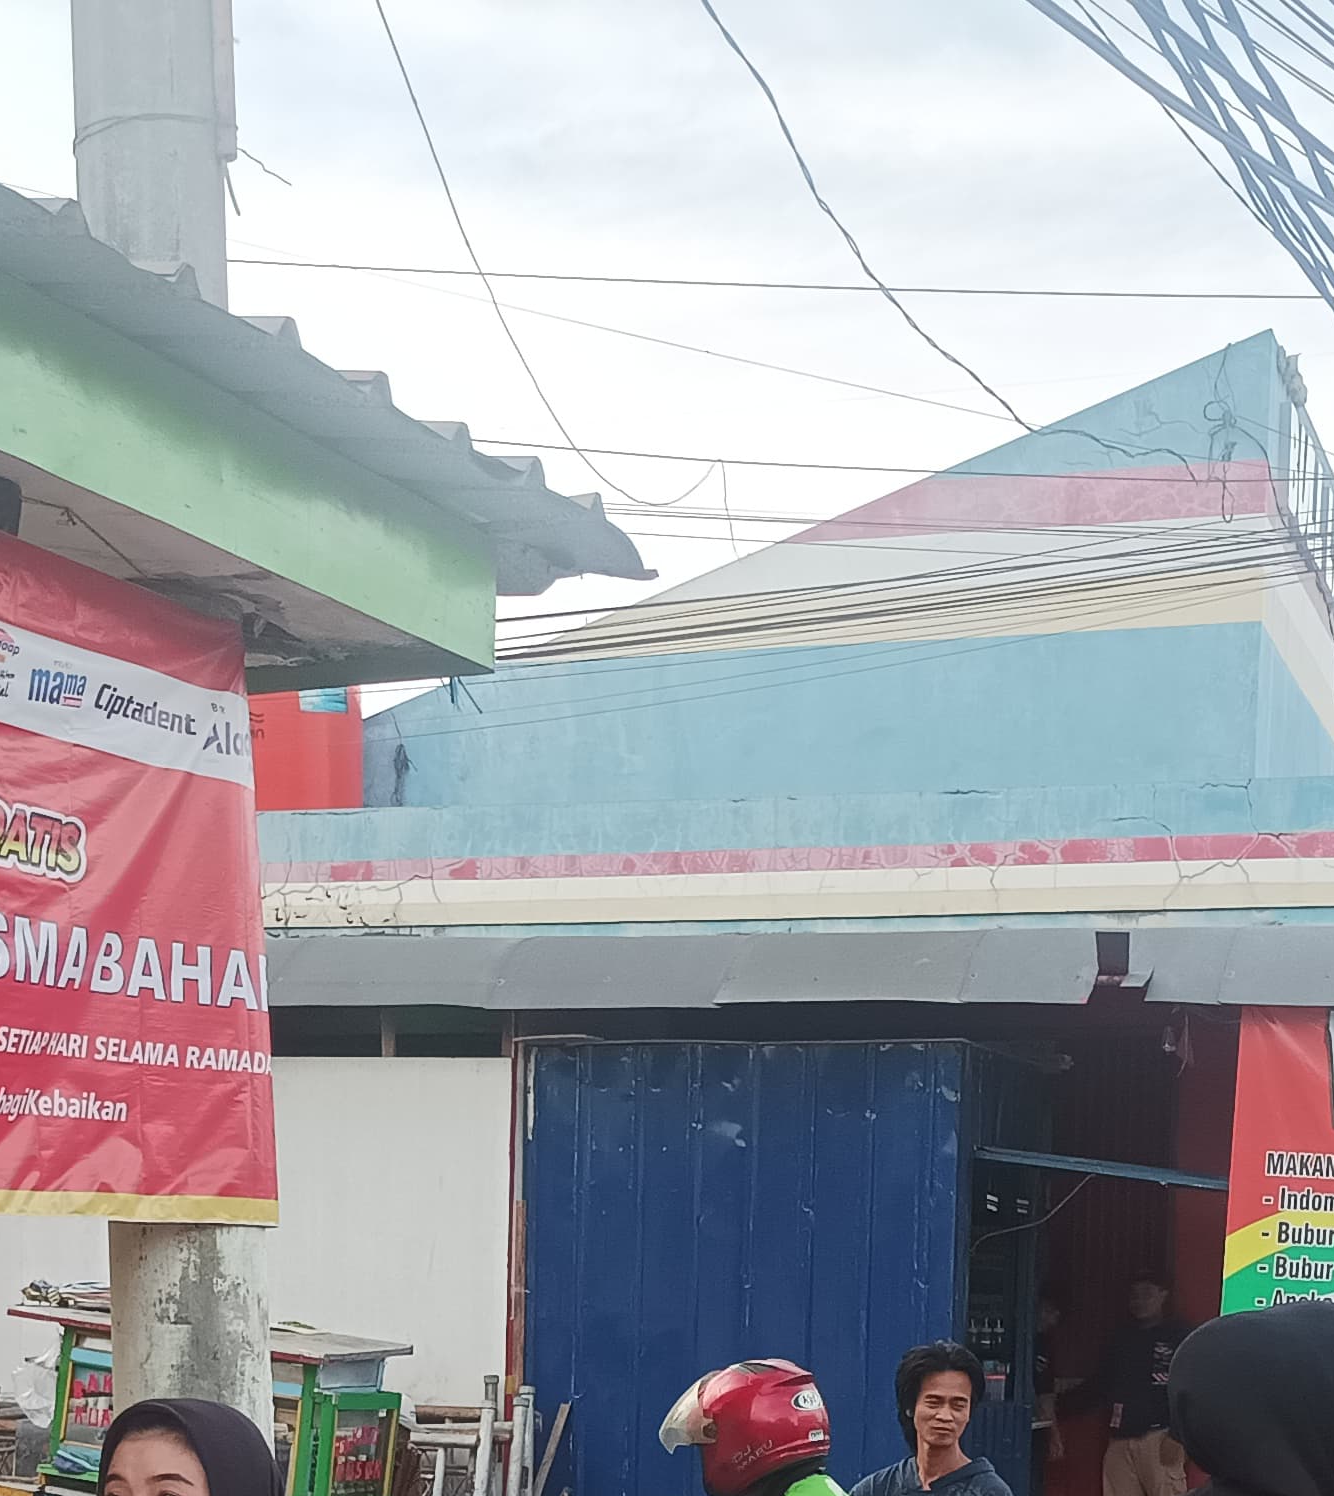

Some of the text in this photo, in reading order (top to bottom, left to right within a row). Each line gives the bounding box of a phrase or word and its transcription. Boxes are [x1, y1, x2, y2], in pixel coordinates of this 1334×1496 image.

[28, 668, 87, 706] mama
[94, 683, 197, 736] Ciptadent
[94, 1036, 180, 1068] SELAMA
[1274, 1256, 1334, 1281] Bubur
